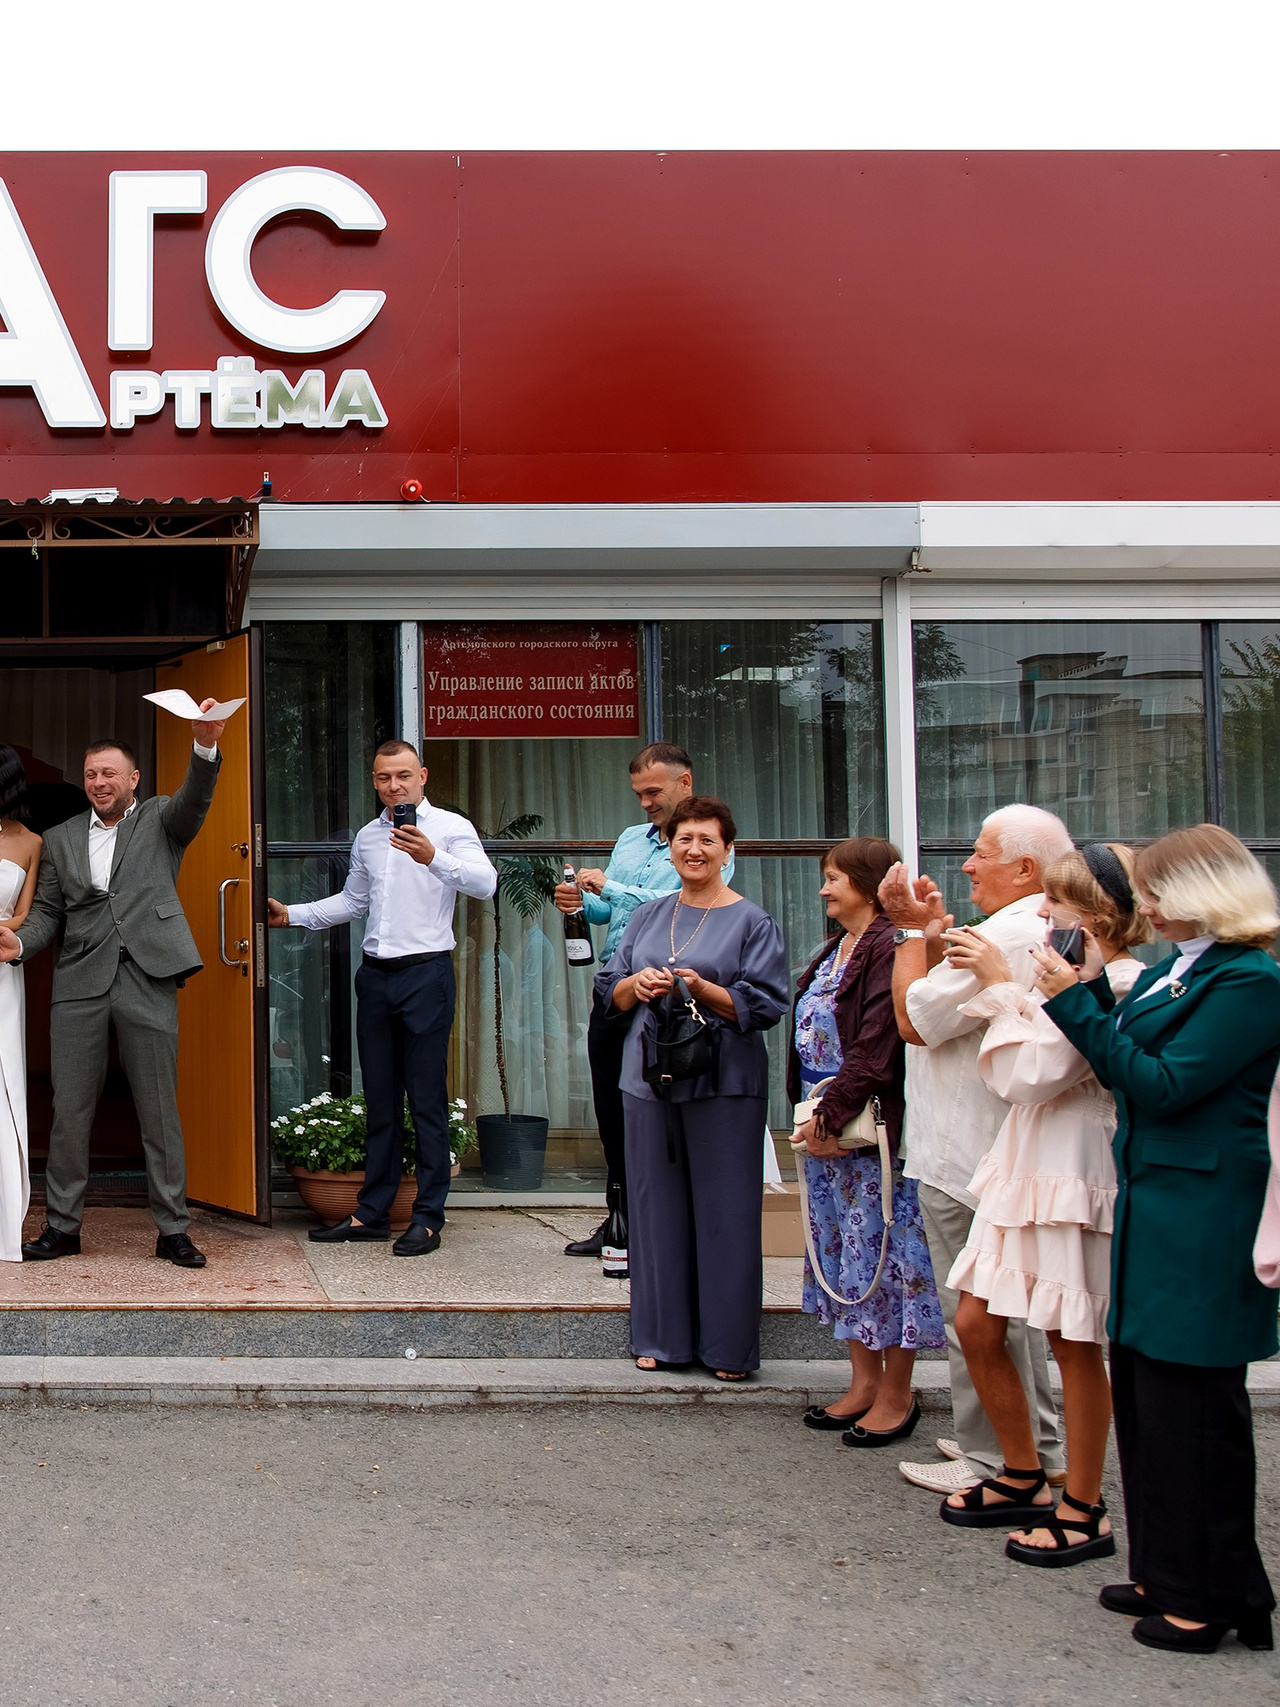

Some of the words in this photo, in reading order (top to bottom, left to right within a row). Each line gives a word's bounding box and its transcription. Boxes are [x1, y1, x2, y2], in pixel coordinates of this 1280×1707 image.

[519, 640, 578, 649] городского
[582, 641, 618, 649] округа
[428, 672, 523, 696] Управление
[530, 676, 584, 690] записи
[592, 674, 635, 690] актов
[429, 705, 544, 725] гражданского
[550, 705, 635, 718] состояния
